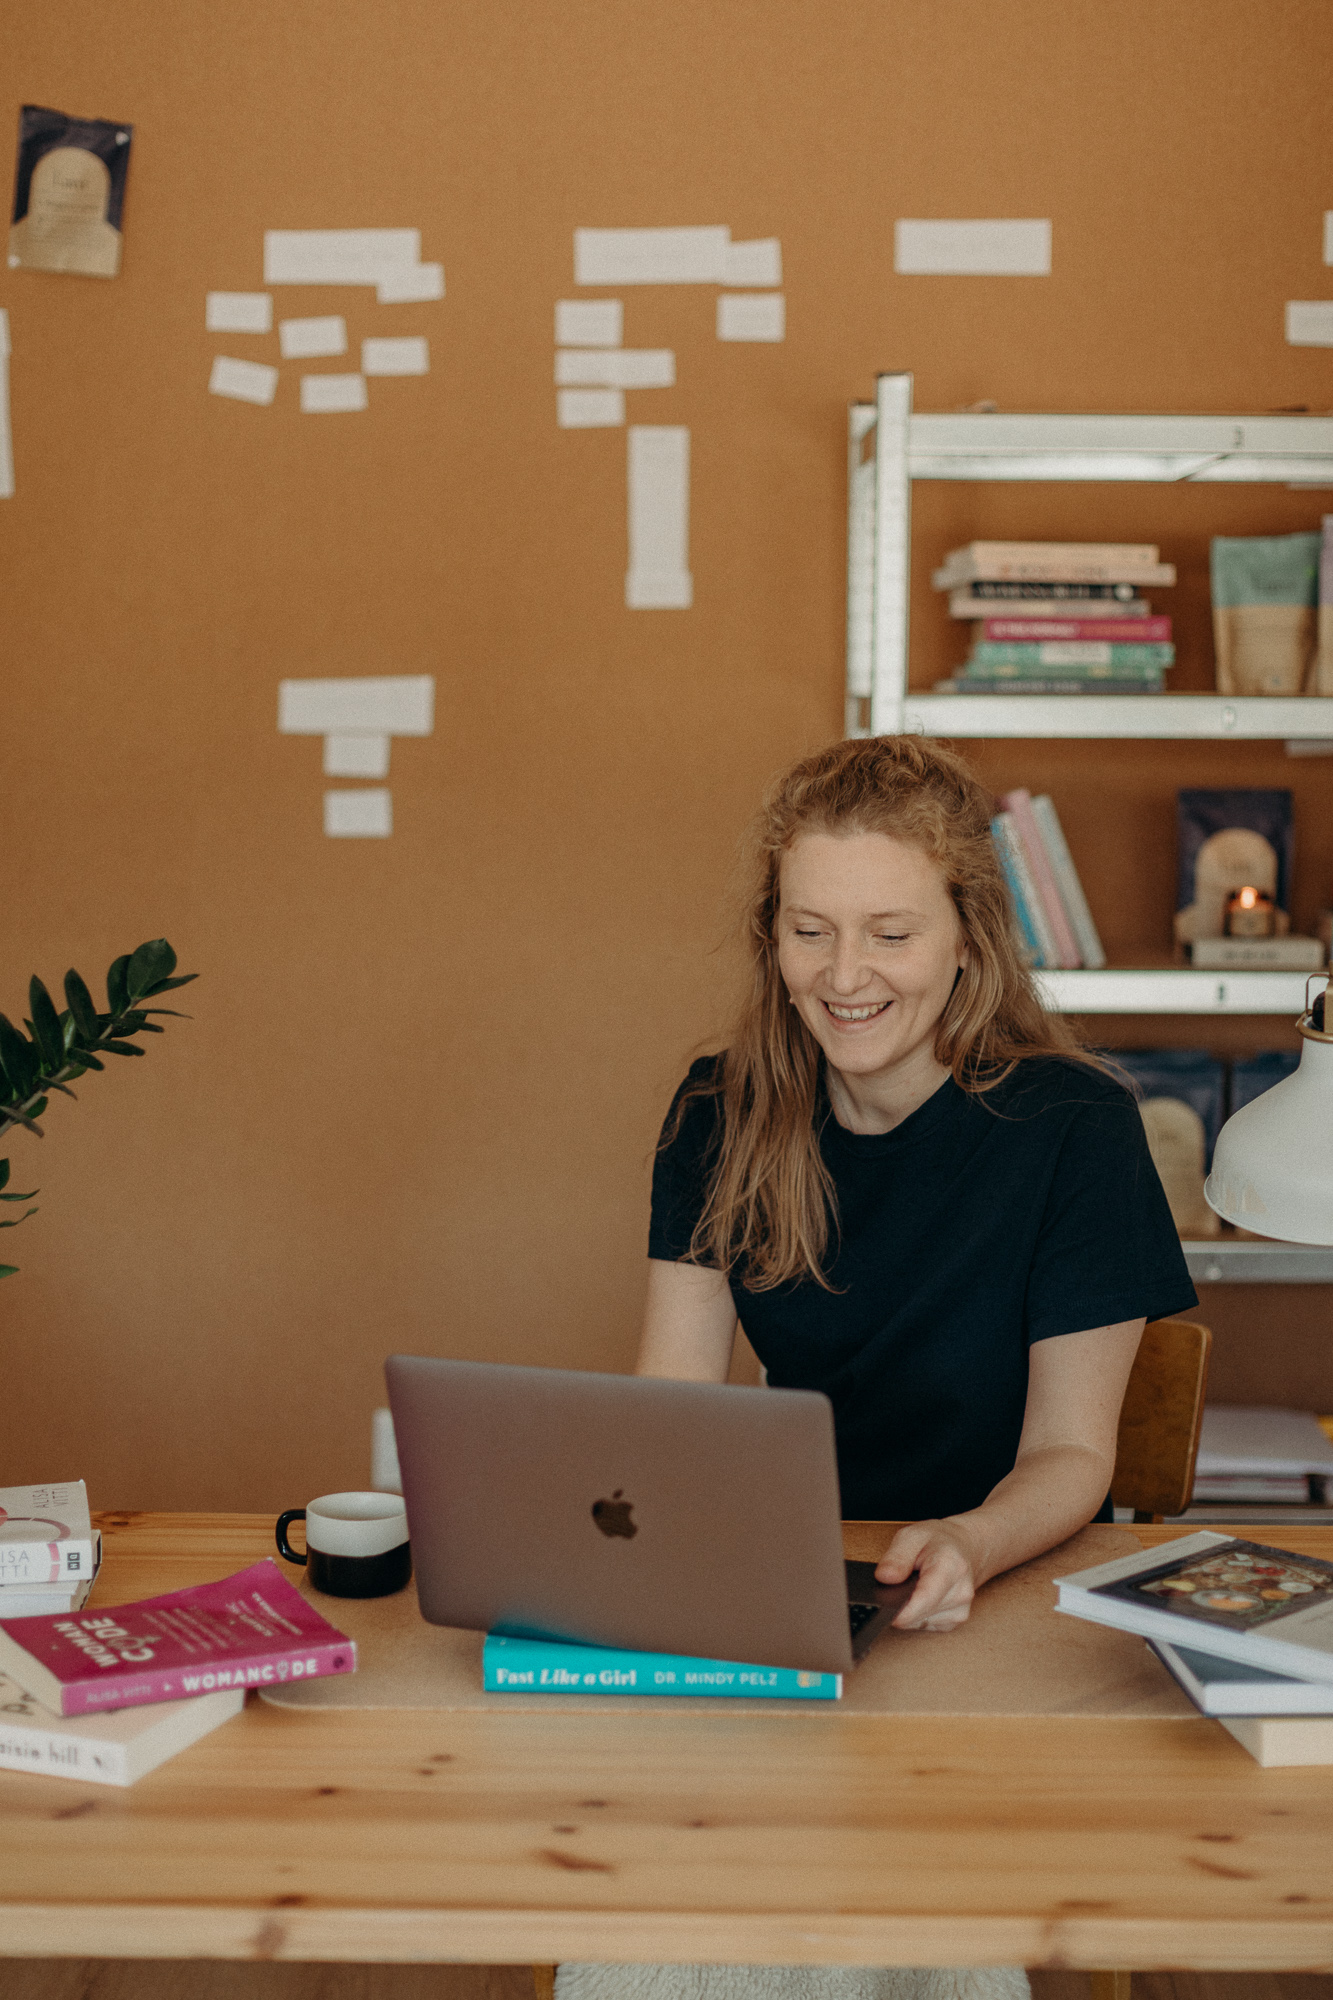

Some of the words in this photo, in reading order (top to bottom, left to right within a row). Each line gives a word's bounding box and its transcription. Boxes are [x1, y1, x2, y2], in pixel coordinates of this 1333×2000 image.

[53, 1621, 119, 1668] WOMAN
[80, 1616, 161, 1662] CODE
[182, 1658, 318, 1691] WOMANCODE
[496, 1667, 535, 1685] Fast
[540, 1668, 581, 1686] Like
[583, 1673, 597, 1686] a
[599, 1669, 637, 1686] Girl
[653, 1670, 680, 1685] DR.
[684, 1671, 735, 1685] MINDY
[739, 1672, 778, 1687] PELZ
